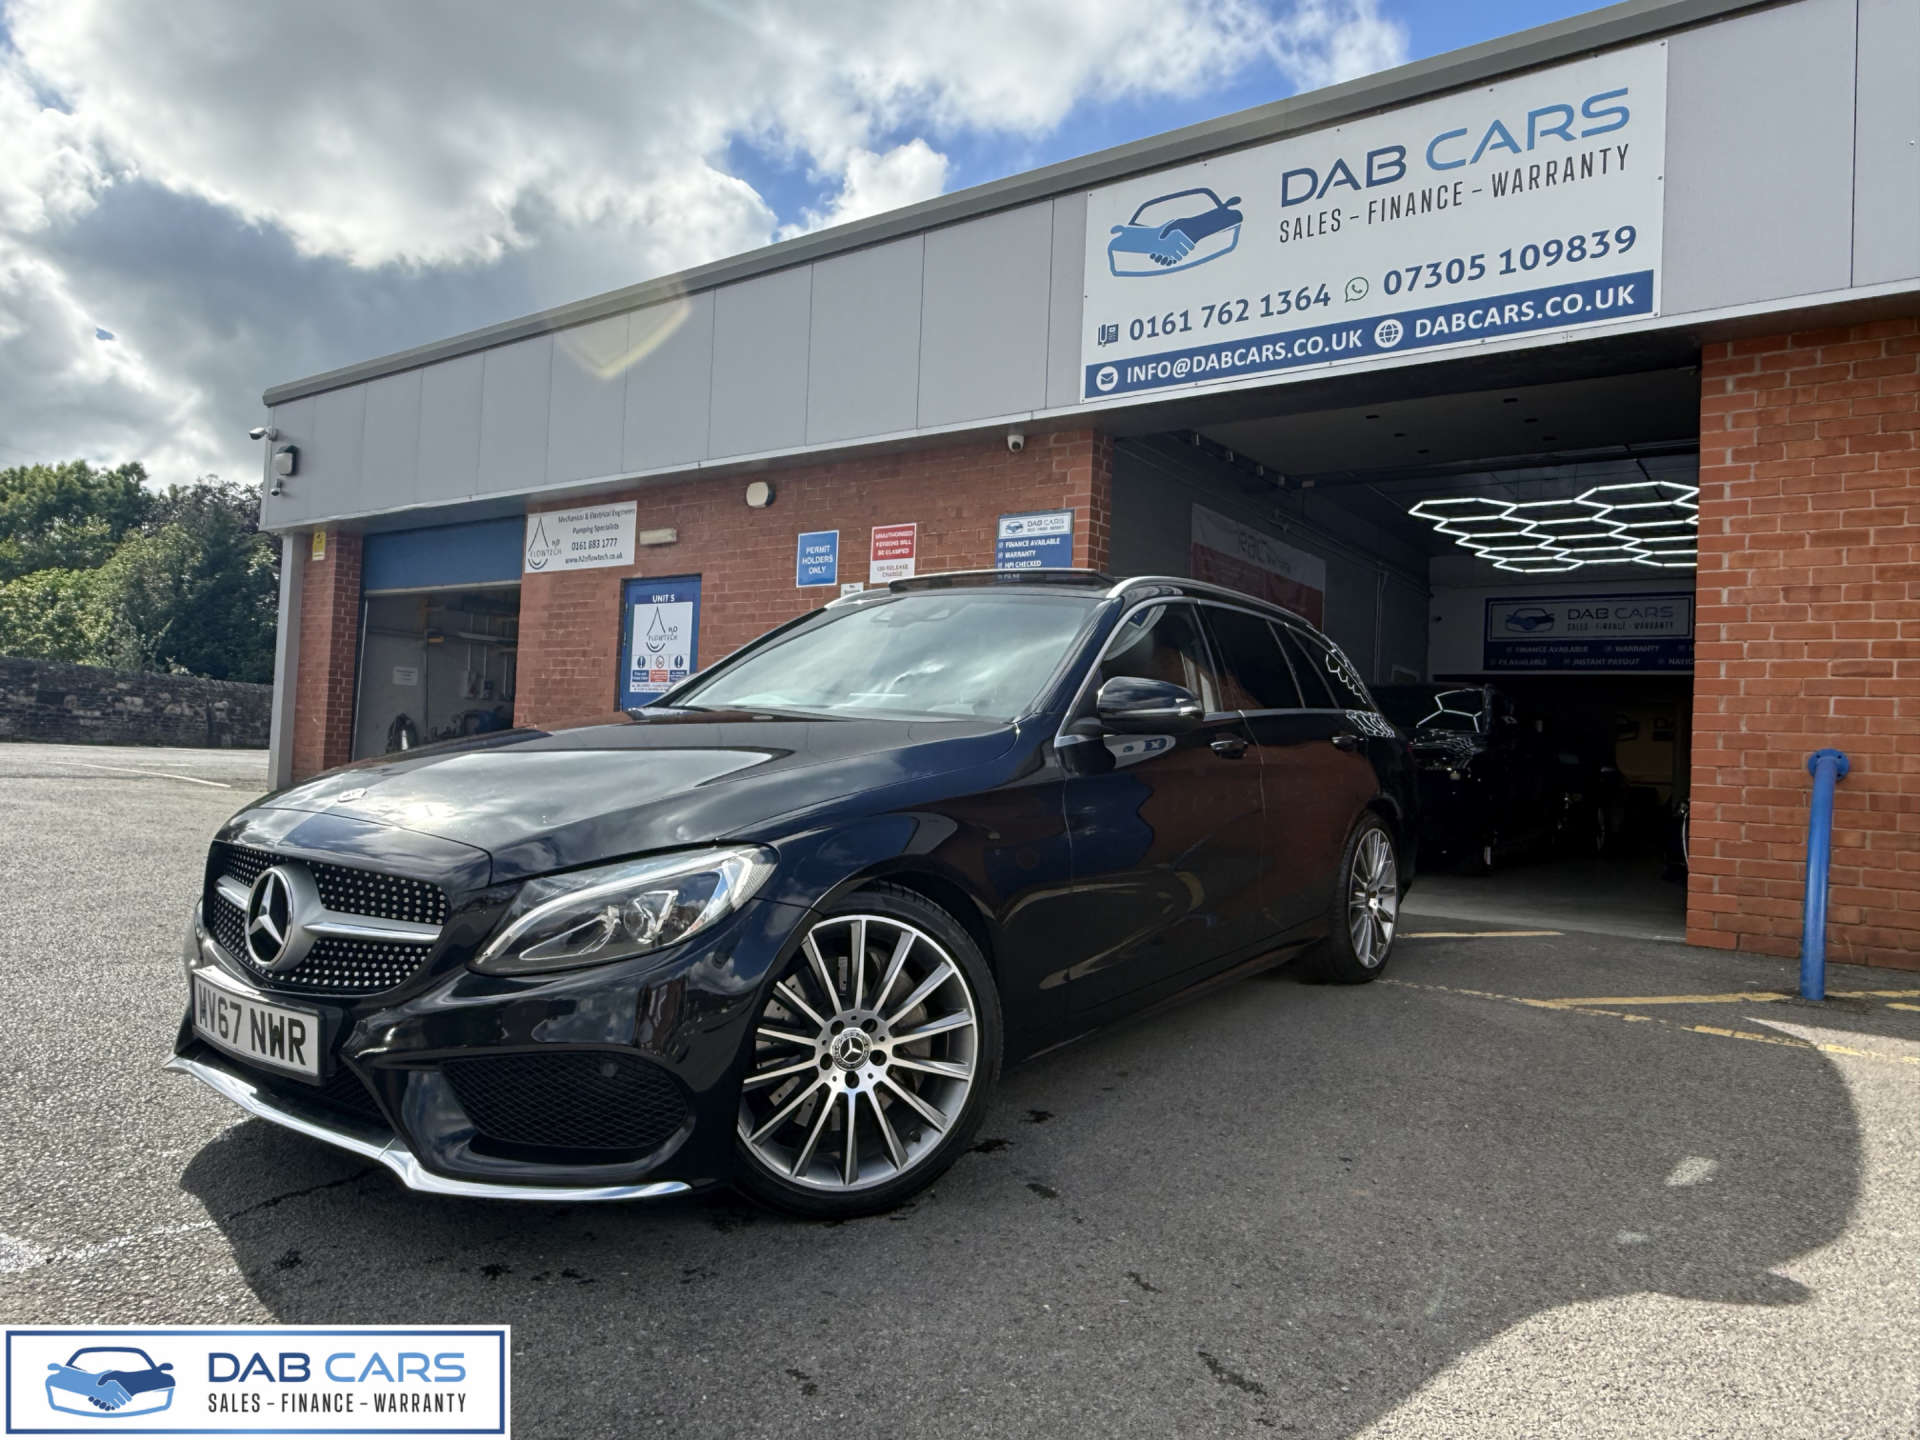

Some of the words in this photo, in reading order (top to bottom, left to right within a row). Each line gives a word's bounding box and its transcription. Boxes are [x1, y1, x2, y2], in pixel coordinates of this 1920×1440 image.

[1281, 145, 1406, 208] DAB
[1426, 87, 1630, 172] CARS
[1280, 208, 1342, 244] SALES
[1367, 181, 1463, 225] FINANCE
[1491, 144, 1630, 198] WARRANTY
[1129, 311, 1192, 341] 0161
[1201, 299, 1250, 329] 762
[1260, 283, 1331, 319] 1364
[1383, 253, 1486, 297] 07305
[1499, 225, 1637, 275] 109839
[1126, 328, 1363, 384] INFO@DABCARS.CO.UK
[1415, 282, 1635, 338] DABCARS.CO.UK
[1027, 519, 1042, 527] DAB
[571, 541, 587, 551] 0161
[601, 537, 618, 548] 1777
[1005, 540, 1029, 548] FINANCE
[1030, 538, 1060, 546] AVAILABLE
[805, 545, 830, 554] PERMIT
[1005, 550, 1036, 558] WARRANTY
[802, 555, 833, 565] HOLDERS
[1015, 560, 1041, 568] CHECKED
[808, 566, 826, 575] ONLY
[652, 594, 668, 603] UNIT
[1567, 607, 1609, 620] DAB
[1614, 606, 1674, 619] CARS
[250, 1007, 306, 1066] NWR
